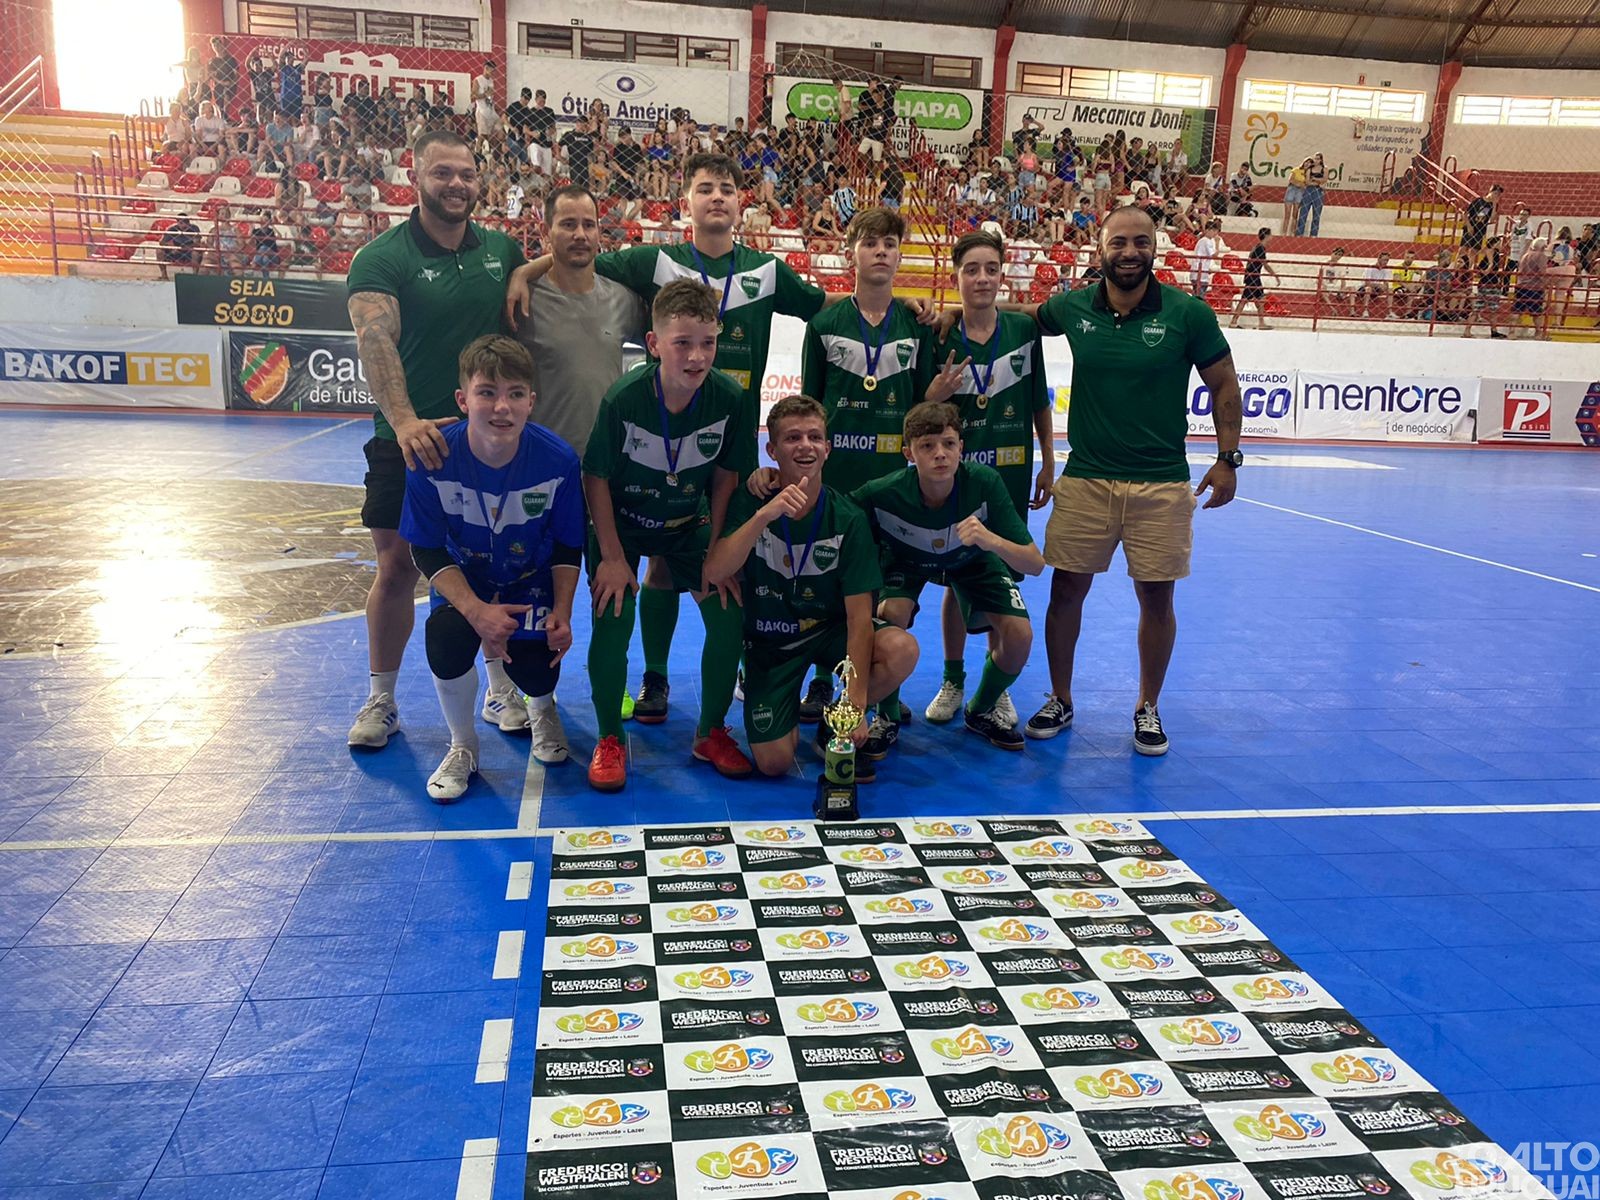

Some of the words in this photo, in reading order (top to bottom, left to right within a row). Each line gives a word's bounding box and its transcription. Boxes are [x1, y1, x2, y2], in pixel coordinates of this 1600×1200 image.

[562, 92, 610, 117] Ótia
[616, 100, 691, 121] Améria
[1072, 104, 1146, 128] Mecanica
[229, 279, 275, 297] SEJA
[214, 297, 294, 326] SÓCIO
[5, 352, 120, 381] BAKOF
[130, 356, 196, 382] TEC
[1504, 383, 1552, 391] FERRAGENS
[309, 388, 331, 403] de
[337, 387, 377, 403] futsa
[1304, 378, 1462, 414] mentore
[1391, 421, 1404, 433] de
[1406, 421, 1448, 436] negócios
[833, 434, 876, 450] BAKOF
[1009, 588, 1026, 610] 8
[523, 605, 553, 631] 12
[756, 619, 798, 634] BAKOF
[801, 1047, 872, 1057] FREDERICO
[546, 1060, 619, 1070] FREDERICO
[546, 1067, 621, 1077] WESTPHALEN
[1187, 1070, 1257, 1082] FREDERICO
[944, 1081, 1014, 1098] FREDERICO
[681, 1102, 758, 1112] FREDERICO
[1350, 1107, 1422, 1122] FREDERICO
[552, 1132, 582, 1140] Esportes
[587, 1129, 621, 1137] Juventude
[1097, 1127, 1173, 1140] FREDERICO
[1102, 1135, 1178, 1147] WESTPHALEN
[830, 1144, 909, 1157] FREDERICO
[834, 1153, 911, 1166] WESTPHALEN
[539, 1163, 623, 1177] FREDERICO
[540, 1171, 624, 1186] WESTPHALEN
[738, 1182, 774, 1190] Juventude
[779, 1179, 798, 1187] Lazer
[1269, 1174, 1350, 1190] FREDERICO
[1275, 1182, 1359, 1198] WESTPHALEN
